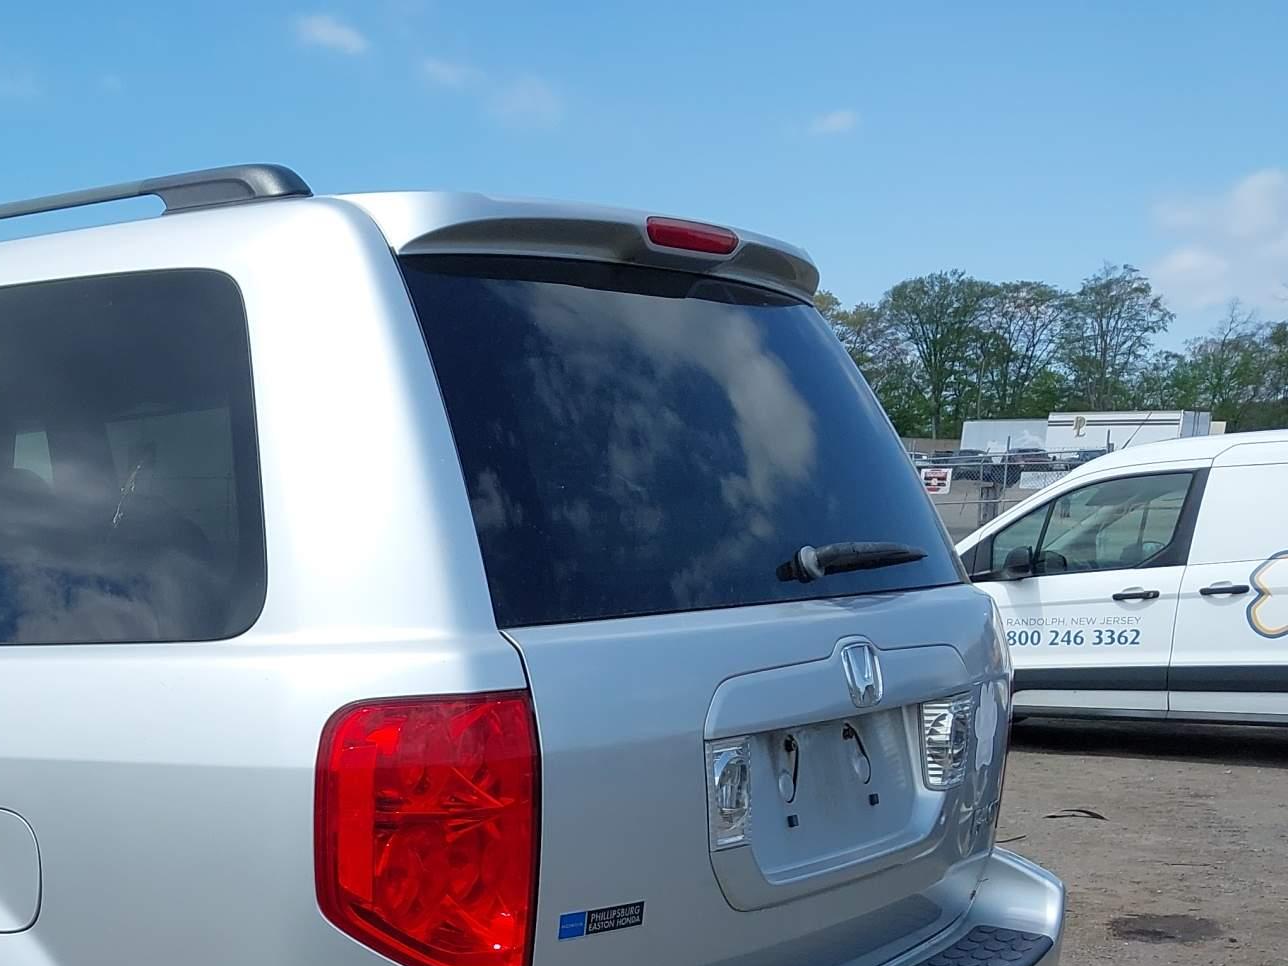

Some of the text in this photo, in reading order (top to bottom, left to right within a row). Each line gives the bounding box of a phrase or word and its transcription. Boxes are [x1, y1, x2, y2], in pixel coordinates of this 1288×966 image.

[1071, 617, 1097, 625] NEW
[1100, 616, 1142, 625] JERSEY
[1006, 628, 1141, 646] 800 246 3362
[590, 905, 641, 923] PHILLIPSBURG
[588, 919, 615, 932] EASTON
[616, 915, 641, 927] HONDA
